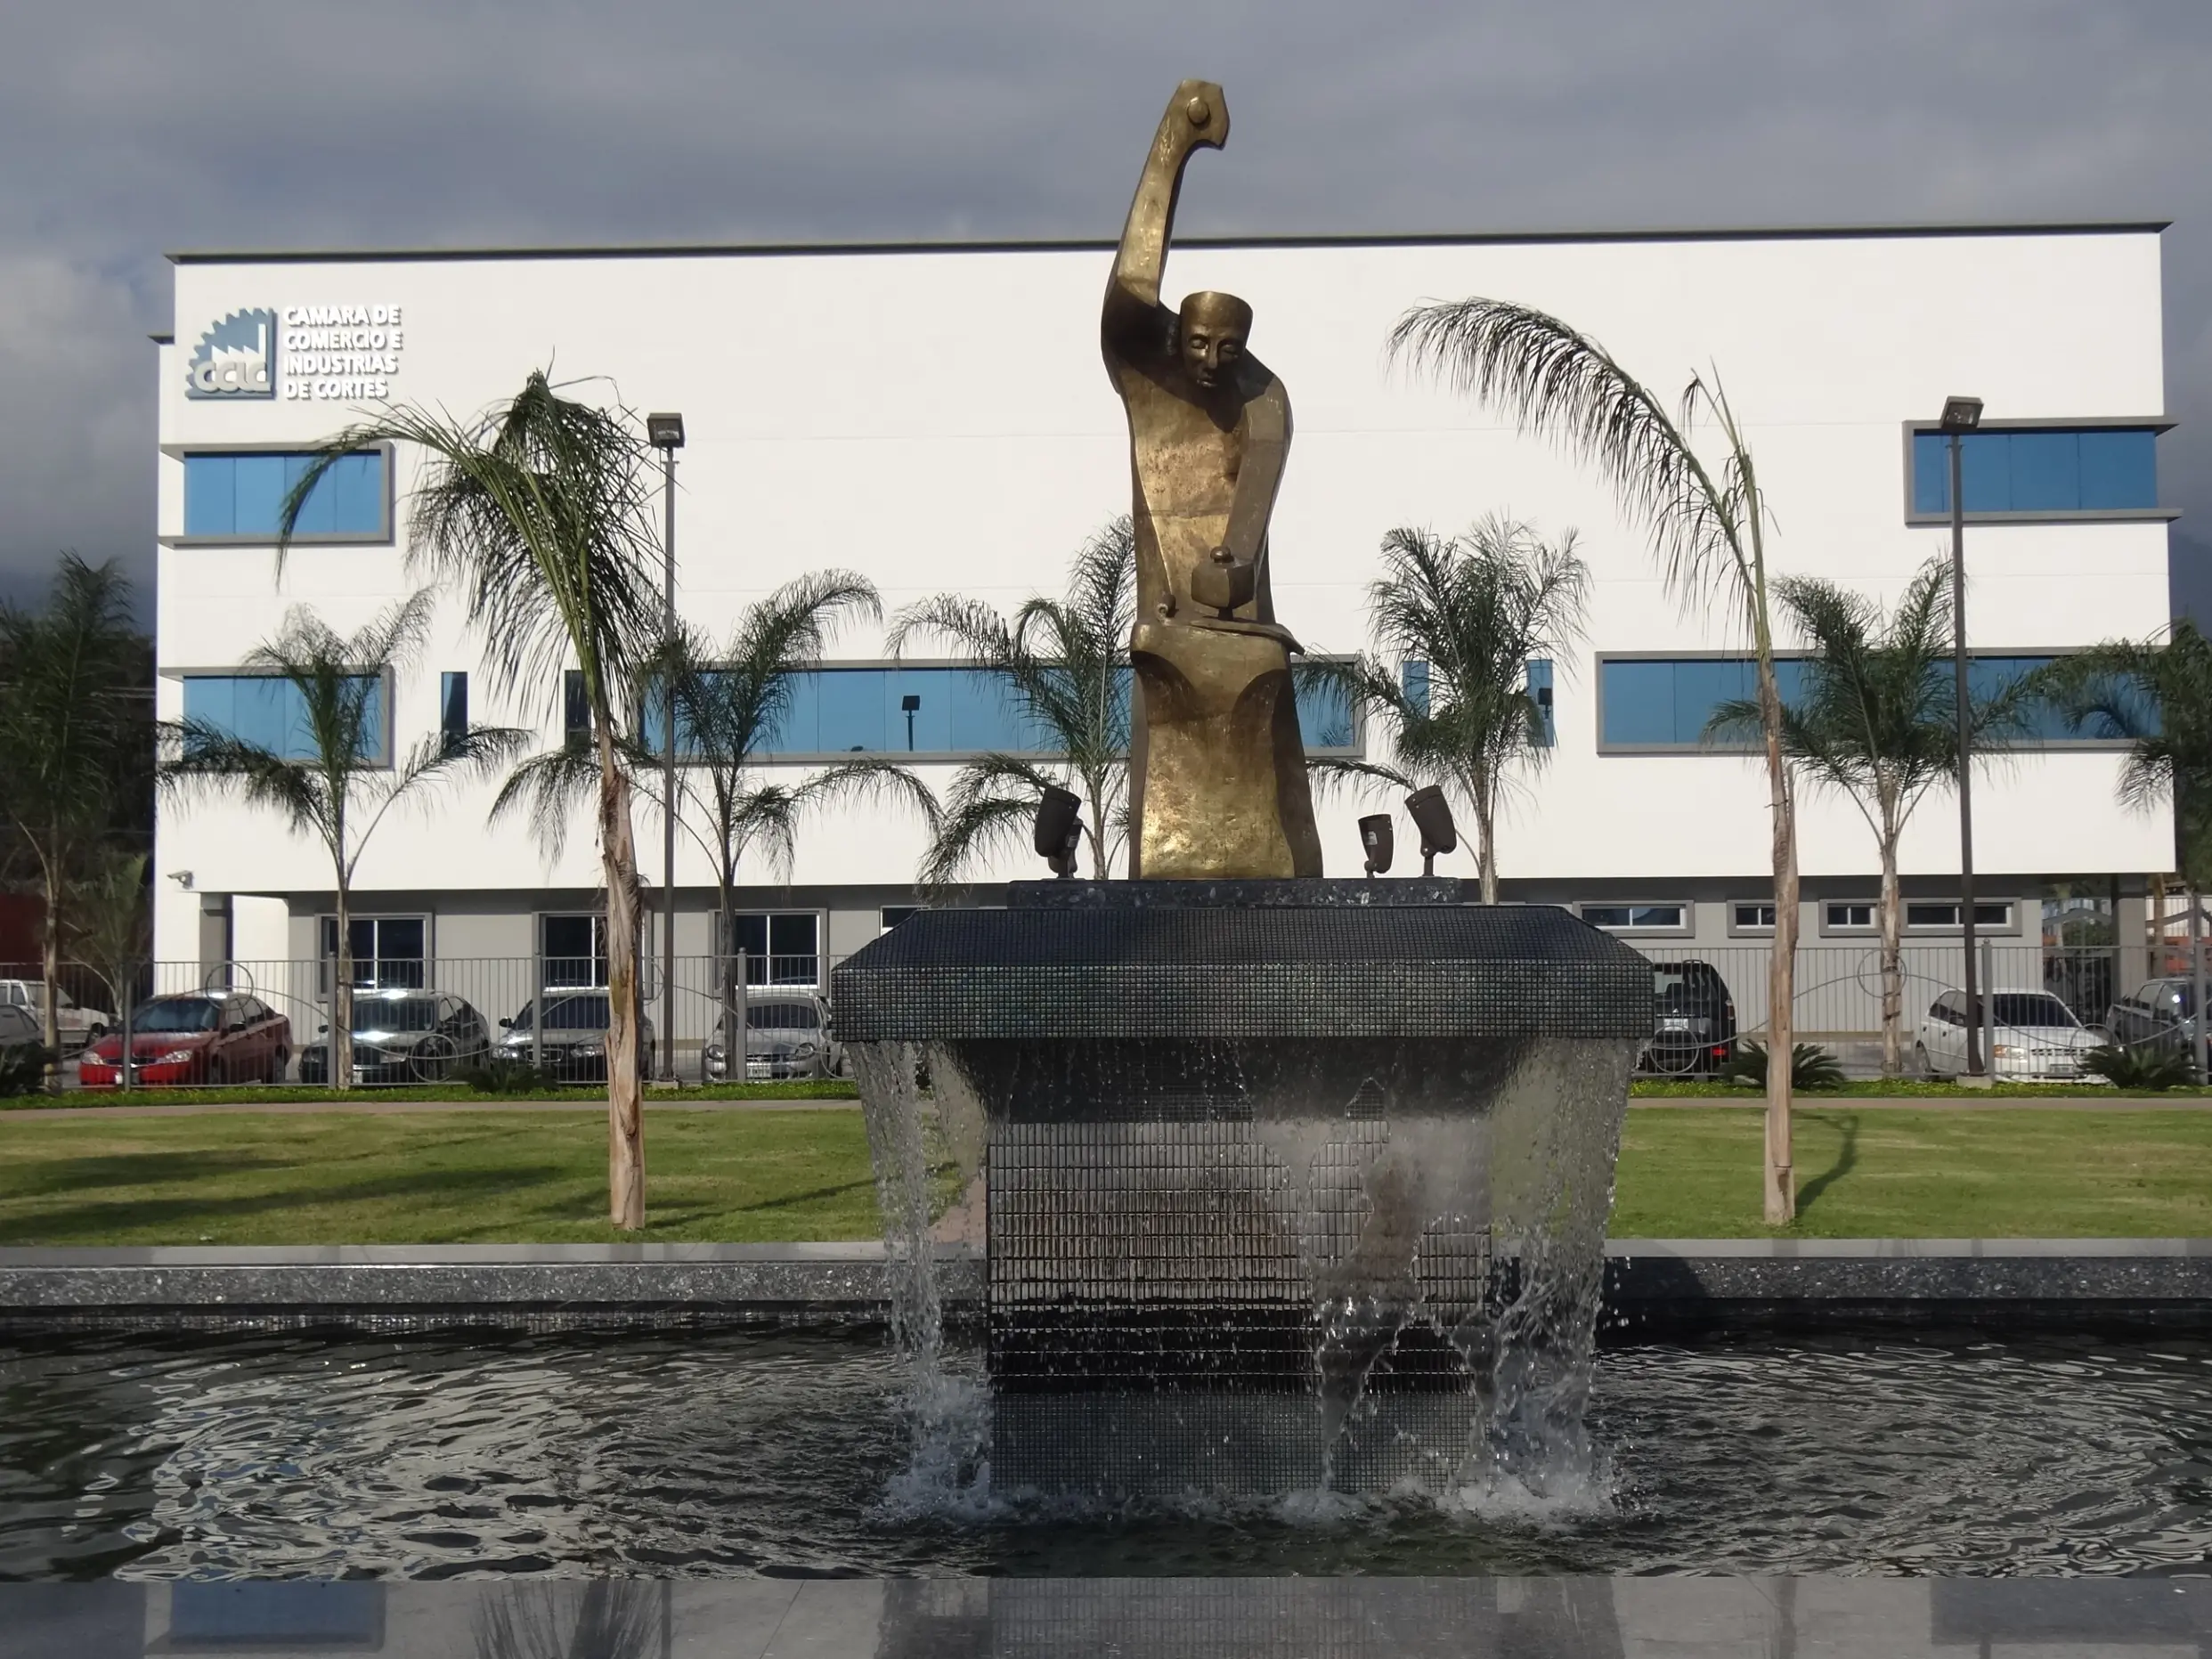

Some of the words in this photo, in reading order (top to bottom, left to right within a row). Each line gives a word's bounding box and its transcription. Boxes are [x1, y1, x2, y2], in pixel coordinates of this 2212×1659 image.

[284, 306, 371, 327] CAMARA
[374, 305, 402, 326] DE
[284, 329, 387, 352] COMERCIO
[391, 330, 404, 351] E
[284, 354, 399, 376] INDUSTRIAS
[284, 379, 311, 400] DE
[313, 378, 389, 400] CORTES
